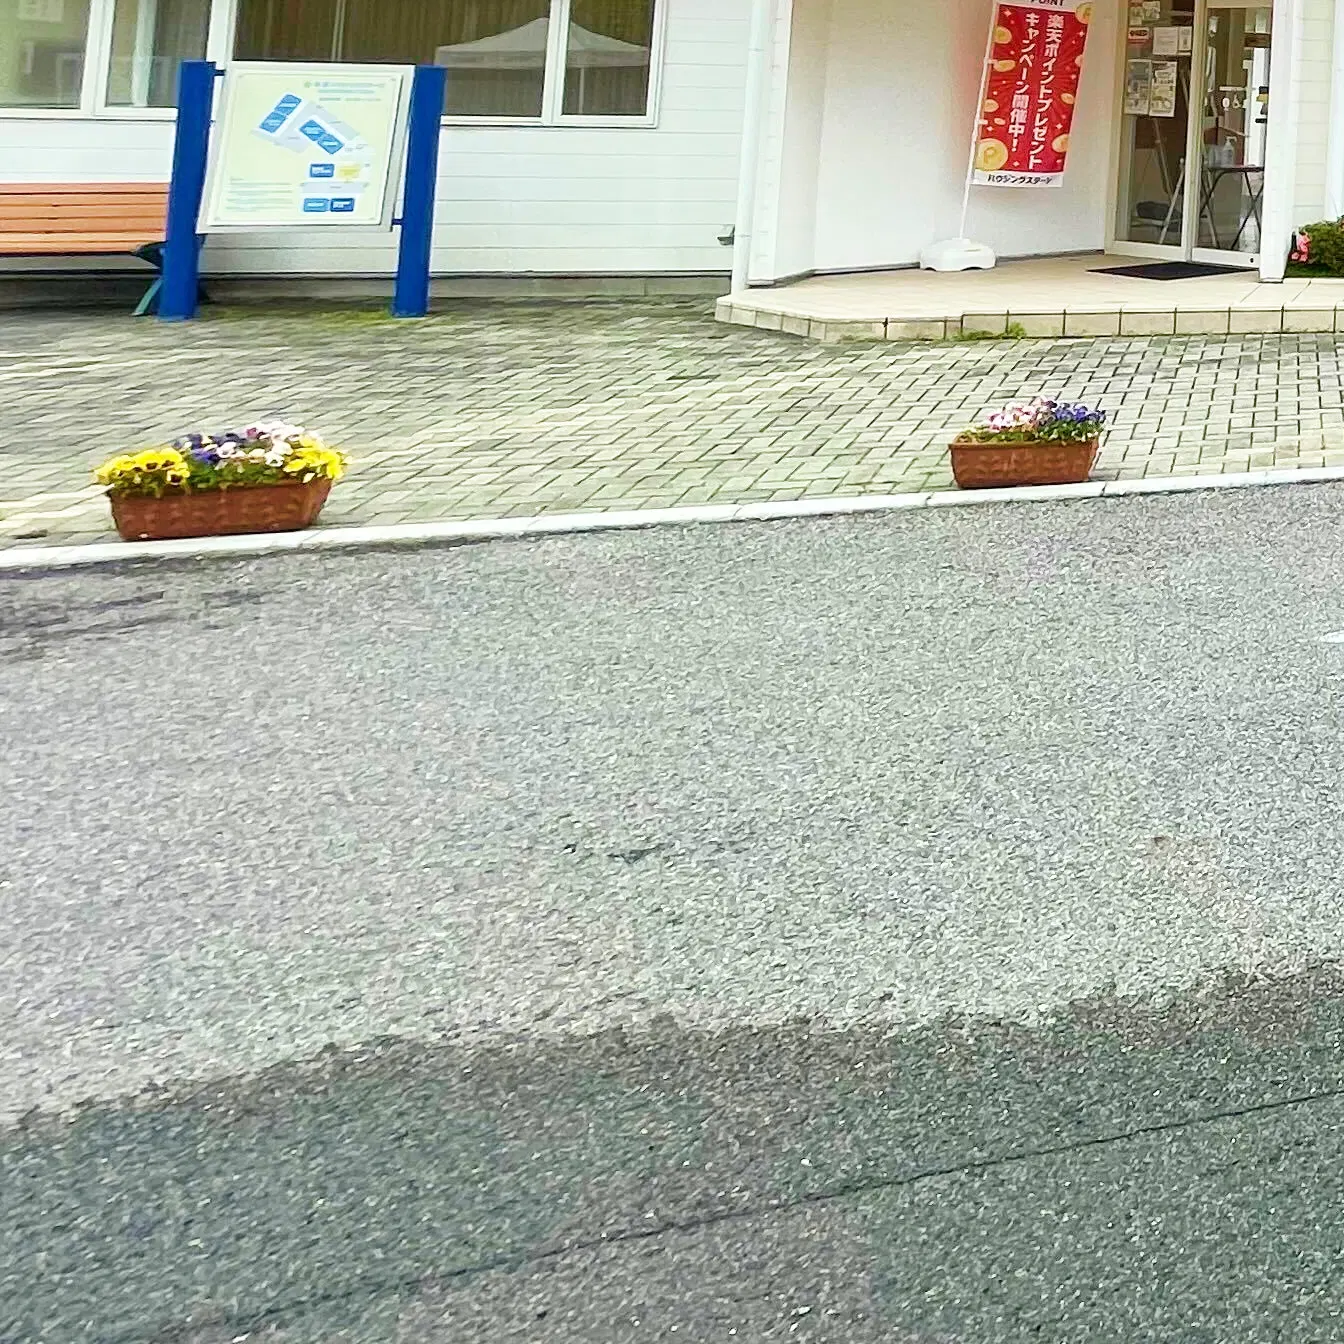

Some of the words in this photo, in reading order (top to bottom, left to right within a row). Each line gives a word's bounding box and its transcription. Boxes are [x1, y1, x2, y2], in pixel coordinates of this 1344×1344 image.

[1028, 13, 1065, 171] 楽天ポイントプレゼント
